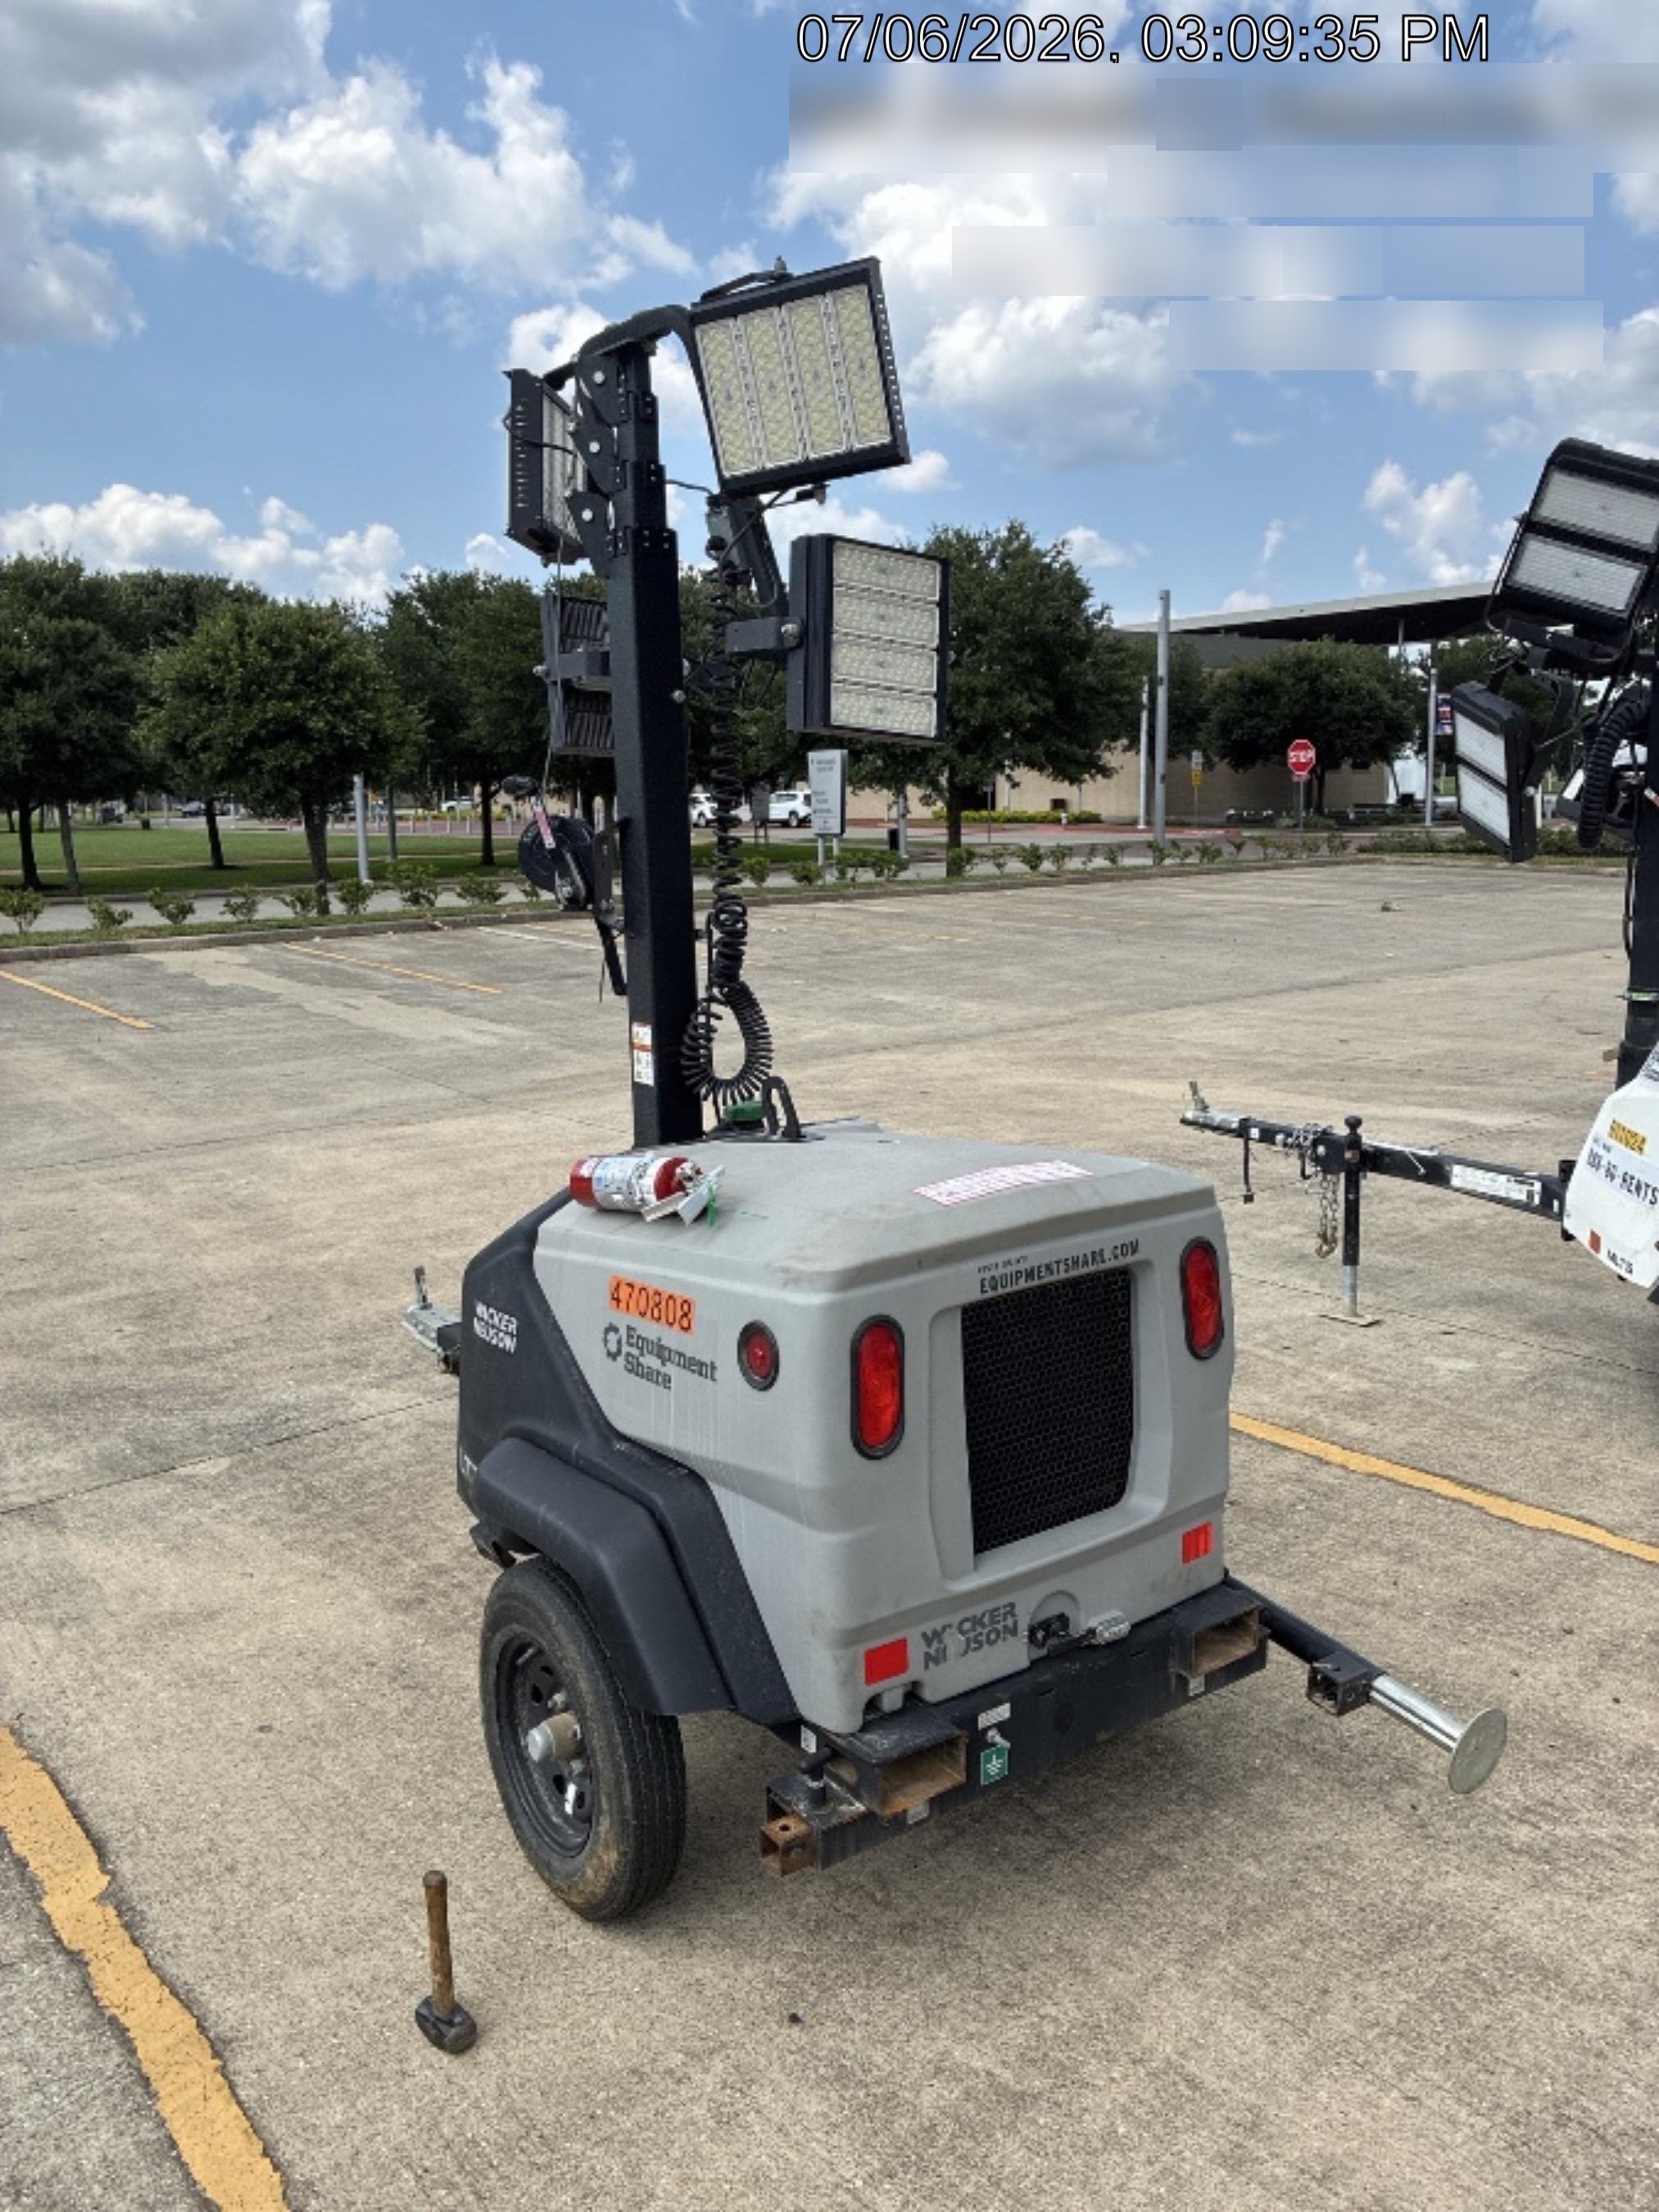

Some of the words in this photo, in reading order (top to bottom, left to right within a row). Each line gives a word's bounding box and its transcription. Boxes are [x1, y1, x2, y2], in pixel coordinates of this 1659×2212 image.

[1290, 749, 1314, 763] STOP
[980, 1238, 1140, 1294] EQUIPMENTSHARE.COM
[610, 1281, 692, 1332] 470808
[624, 1352, 672, 1390] Share
[625, 1324, 718, 1382] Equipment
[921, 1602, 1018, 1648] WCKER
